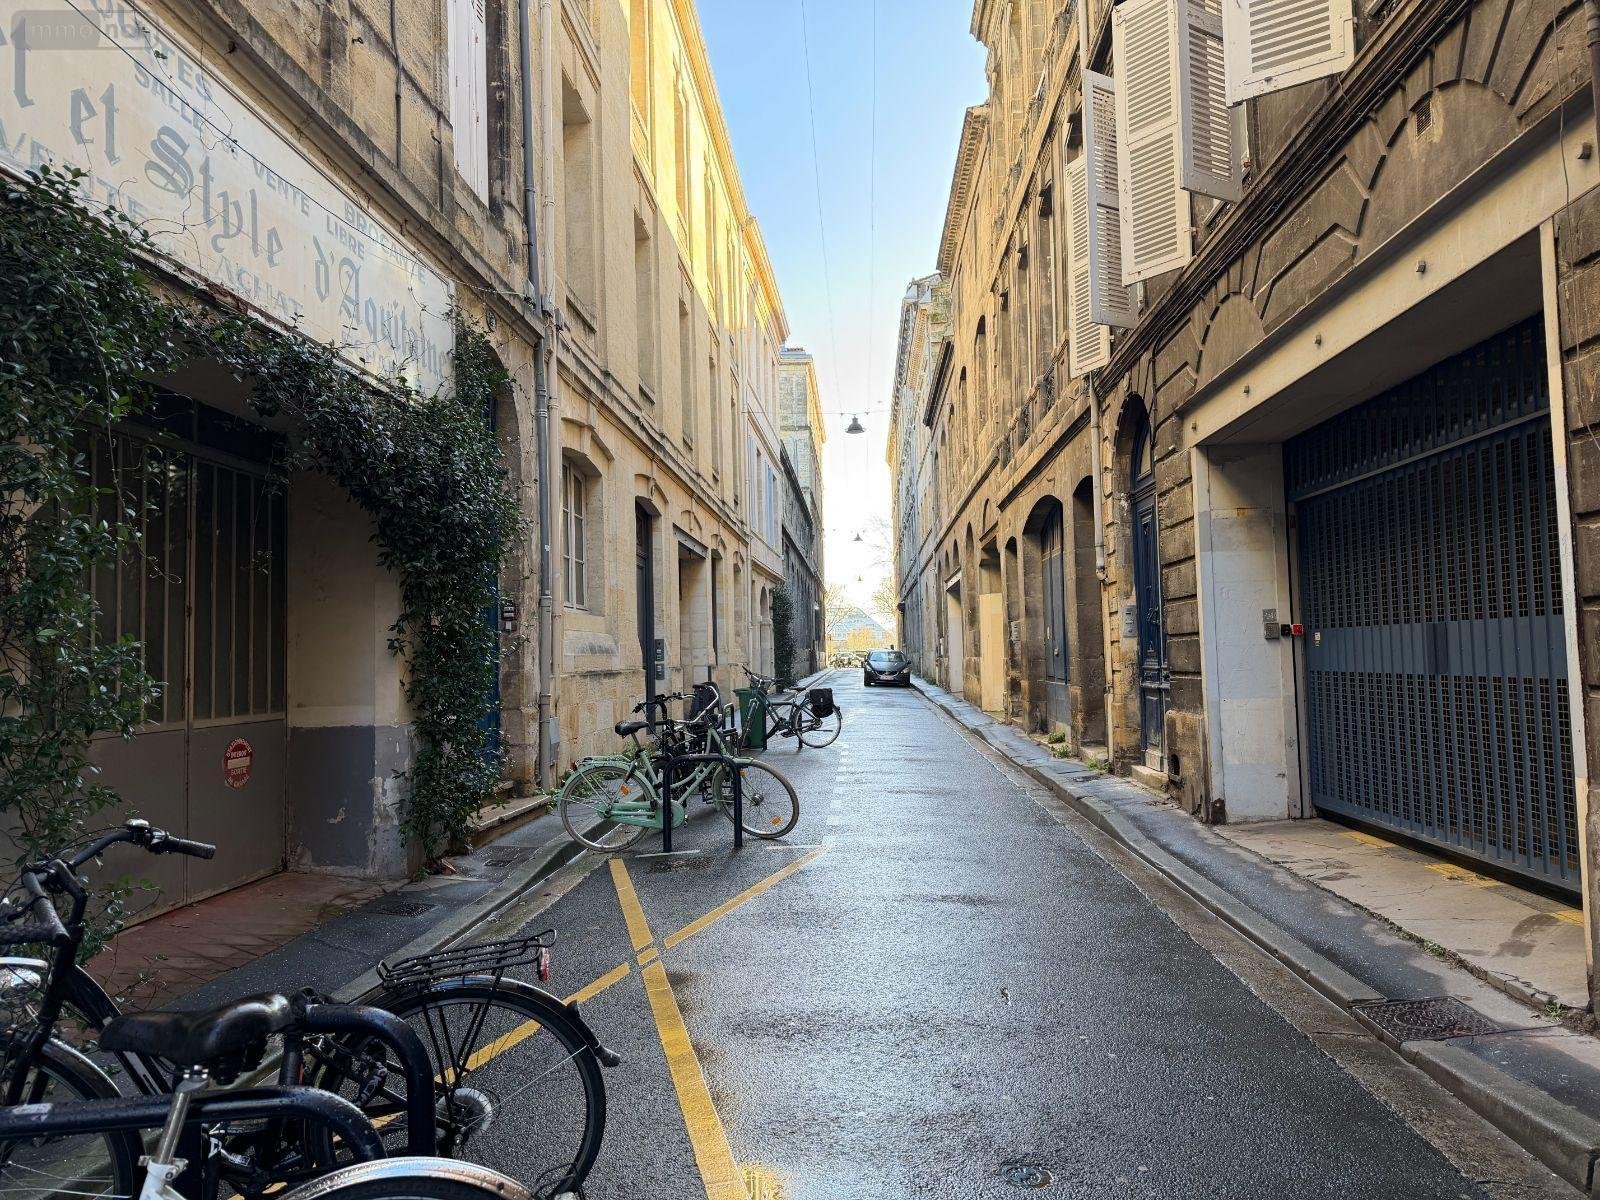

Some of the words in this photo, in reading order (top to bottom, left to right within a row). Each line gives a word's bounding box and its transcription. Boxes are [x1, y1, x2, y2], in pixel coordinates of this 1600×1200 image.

[69, 82, 121, 168] et
[144, 125, 284, 268] Style
[252, 157, 310, 217] VENTE
[326, 213, 366, 260] LIBRE
[343, 200, 427, 286] BROCANTE
